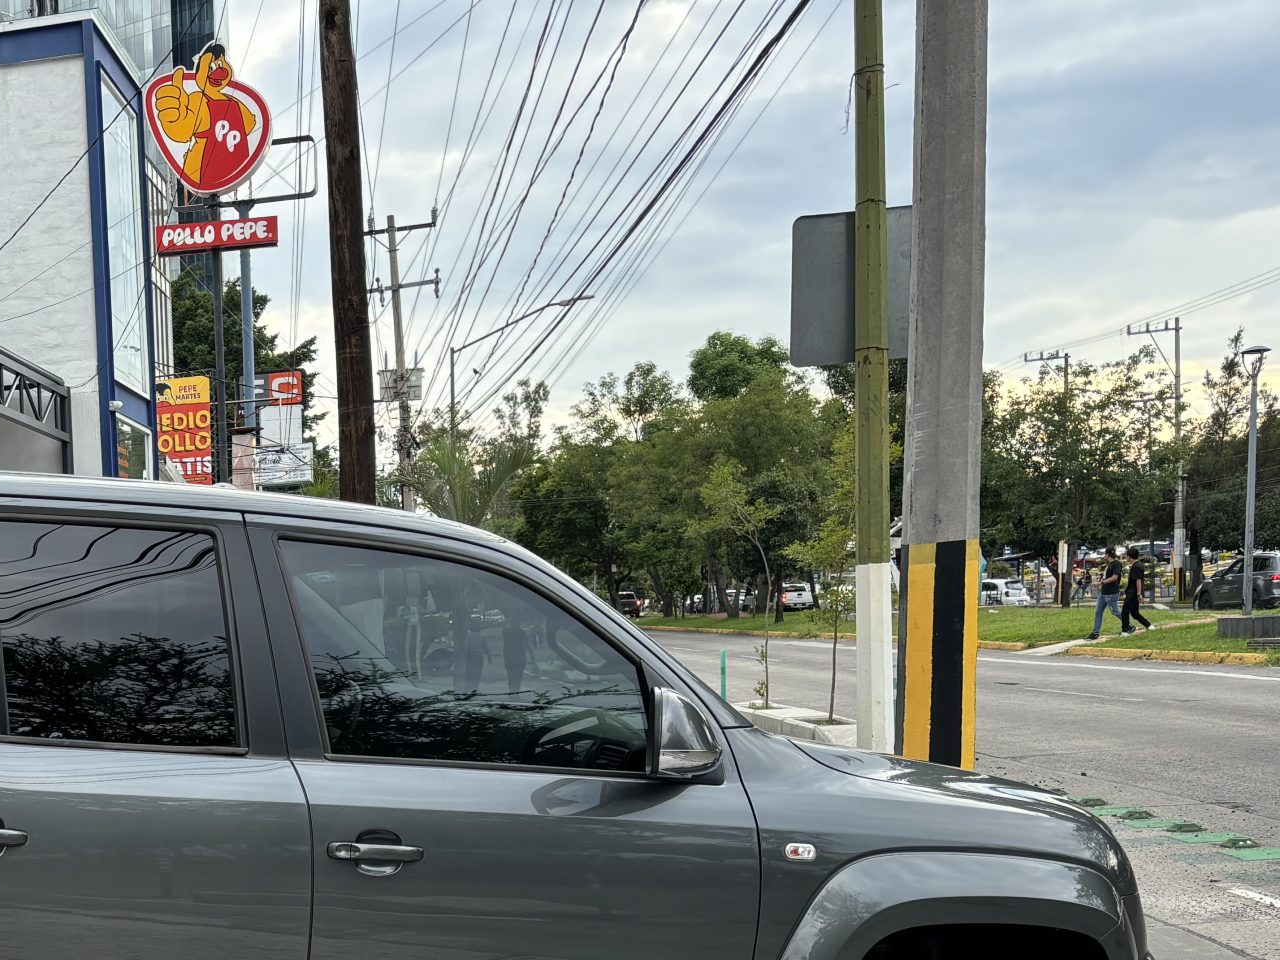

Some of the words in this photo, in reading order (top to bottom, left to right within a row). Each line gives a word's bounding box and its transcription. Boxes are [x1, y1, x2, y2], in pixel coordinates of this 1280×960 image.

[162, 225, 215, 247] POLLO
[178, 384, 198, 393] PEPE
[174, 392, 201, 401] MARTES
[157, 409, 211, 433] EDIO
